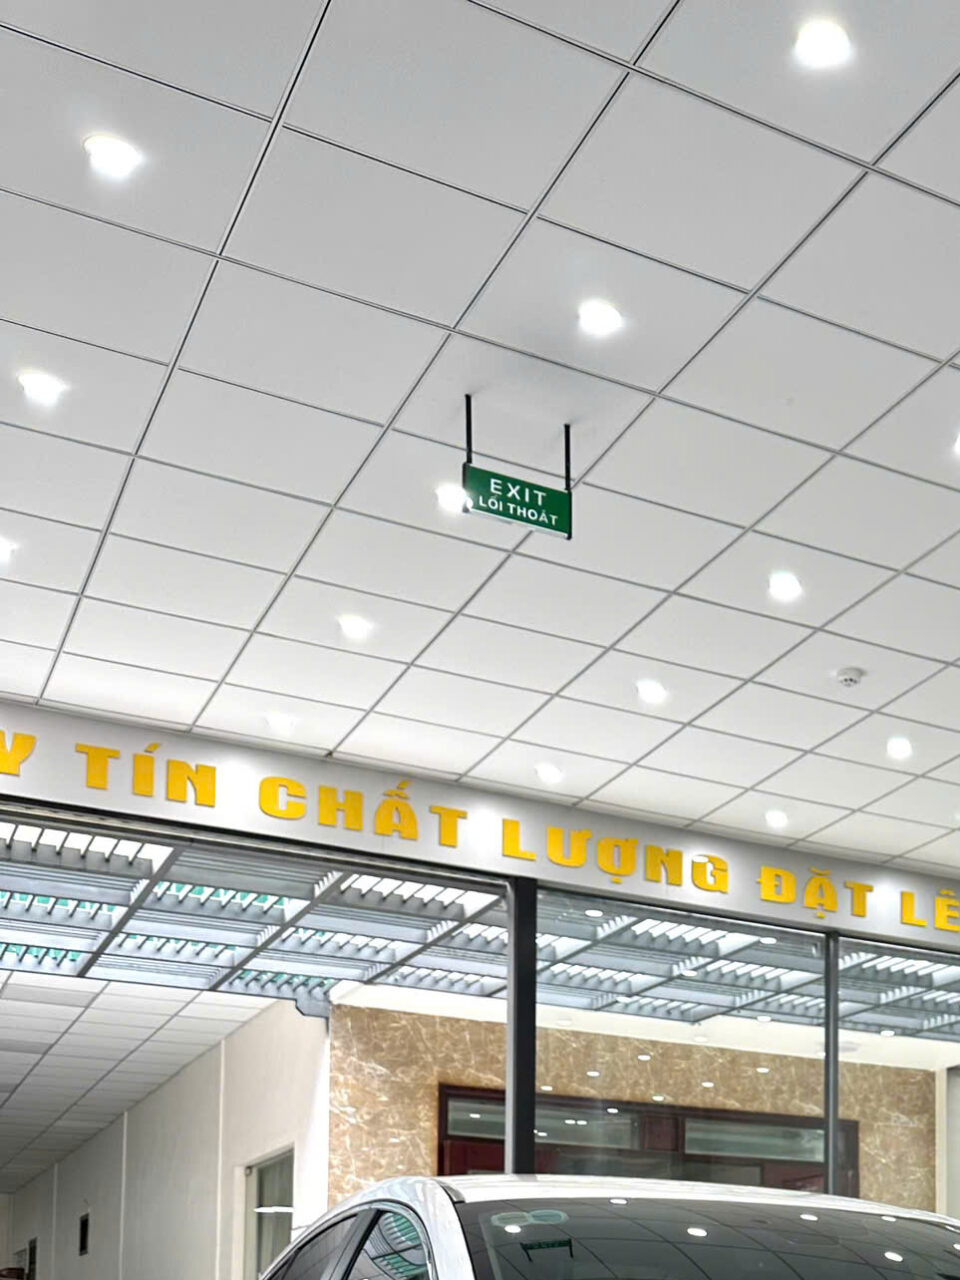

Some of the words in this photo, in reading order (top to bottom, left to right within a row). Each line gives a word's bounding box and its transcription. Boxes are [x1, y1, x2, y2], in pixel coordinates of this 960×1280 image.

[489, 478, 546, 506] EXIT
[507, 503, 558, 526] THOÁT
[76, 742, 217, 808] TÍN
[259, 779, 468, 849] CHẤT
[502, 818, 730, 894] LƯỢNG
[757, 865, 874, 919] ĐẶT
